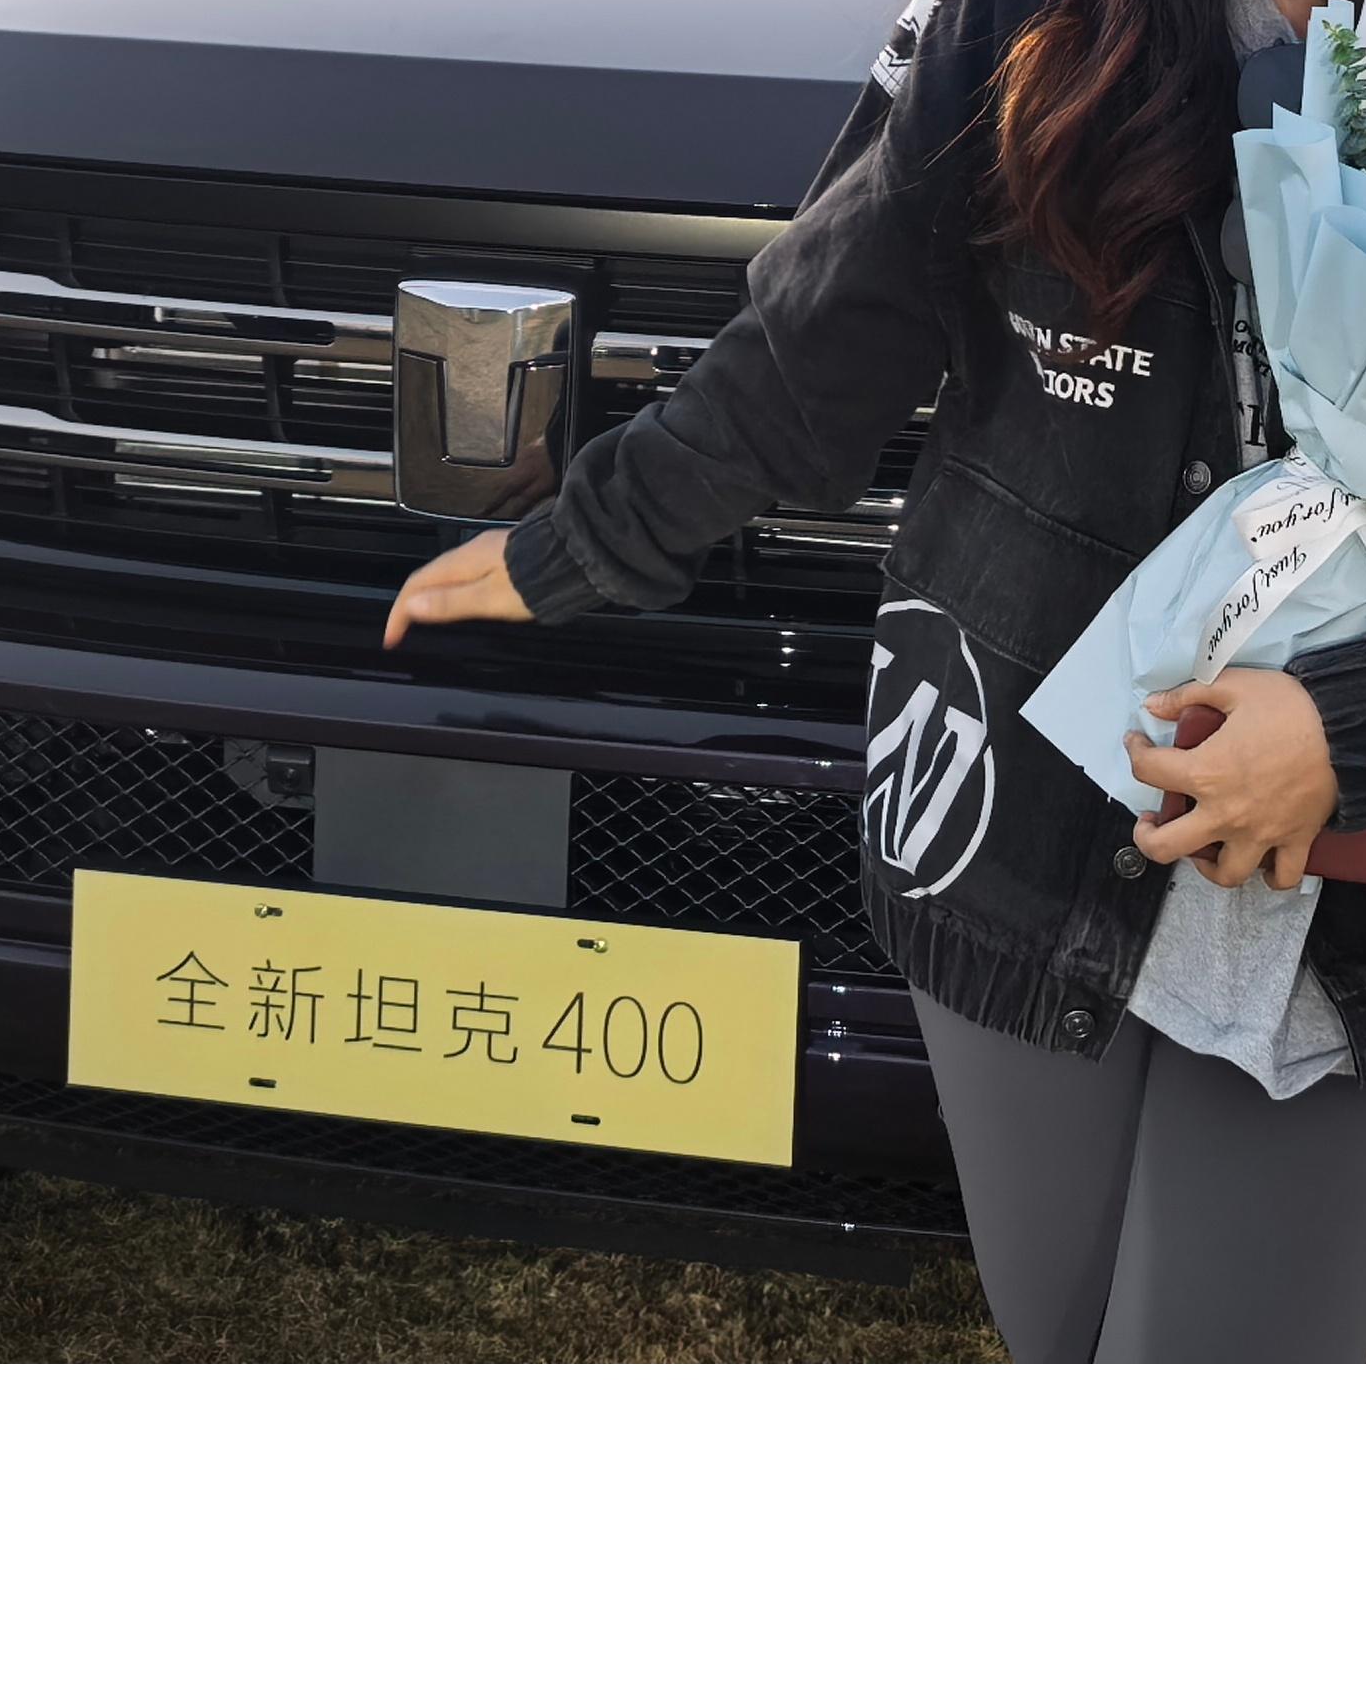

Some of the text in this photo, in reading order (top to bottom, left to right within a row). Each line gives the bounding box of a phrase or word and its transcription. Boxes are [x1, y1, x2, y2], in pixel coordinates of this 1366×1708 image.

[1302, 487, 1343, 523] for
[1260, 545, 1307, 588] Just
[1234, 569, 1265, 620] for
[155, 949, 705, 1085] 全新坦克400
